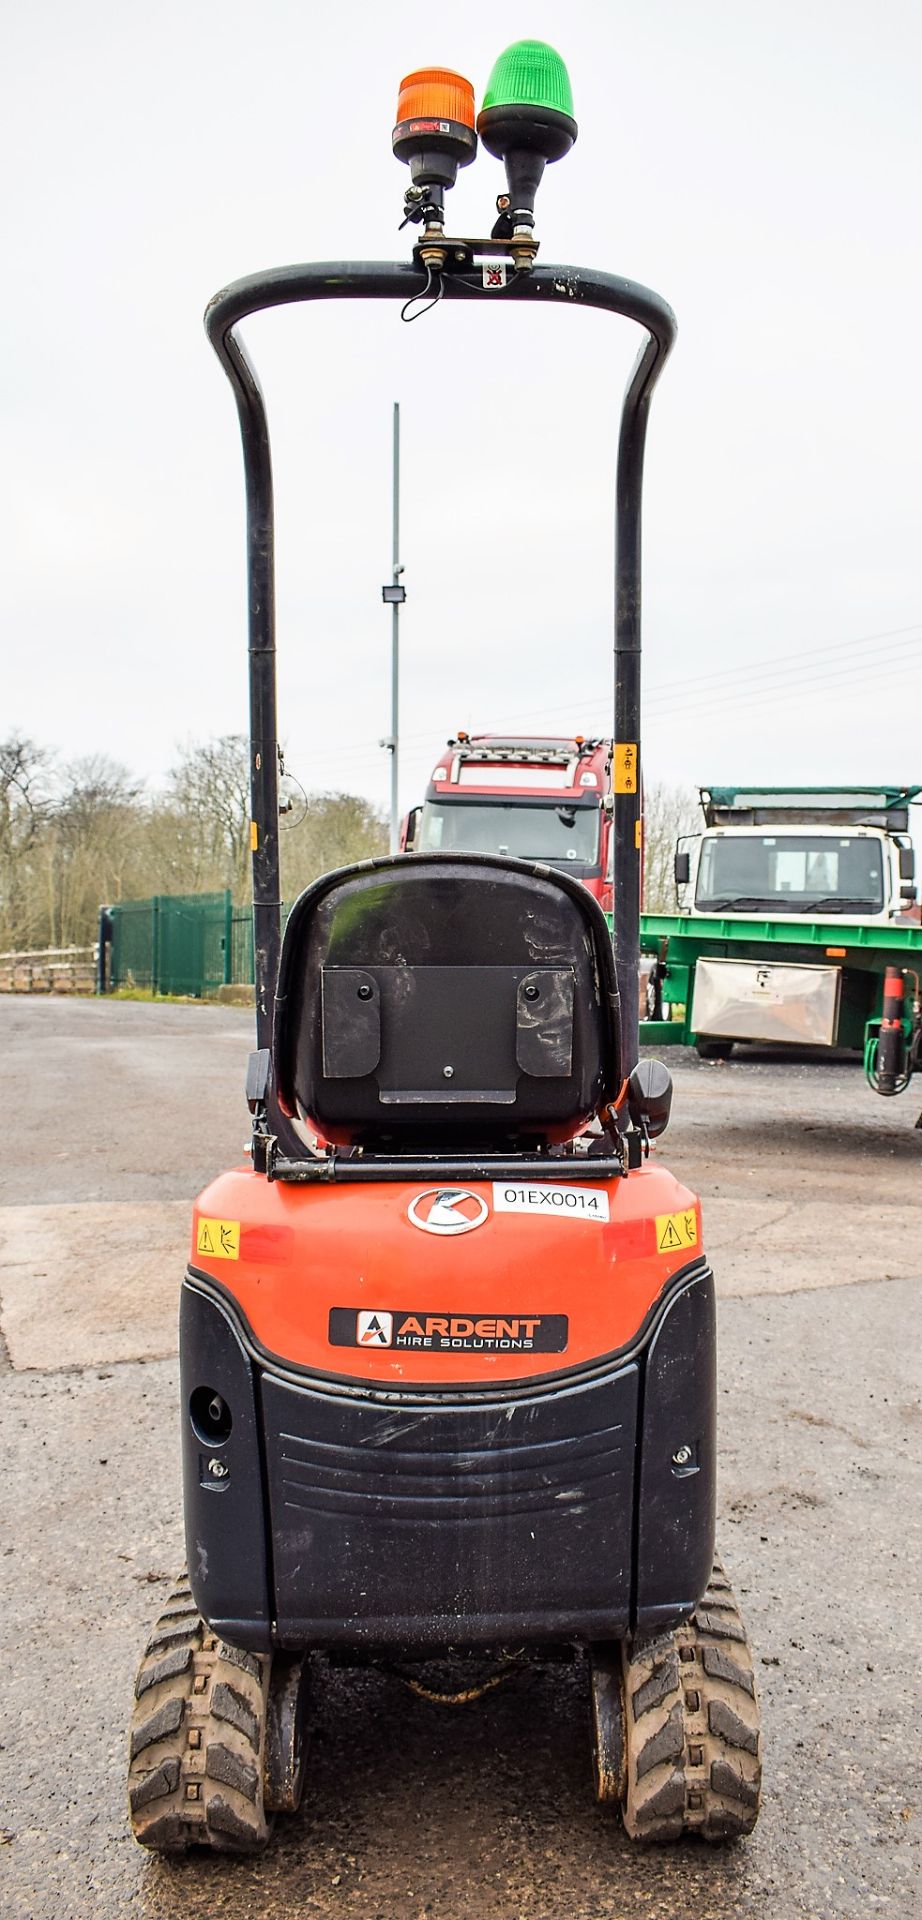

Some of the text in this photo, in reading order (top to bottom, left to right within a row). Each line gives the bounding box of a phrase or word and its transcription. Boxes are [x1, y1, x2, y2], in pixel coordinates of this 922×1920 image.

[504, 1189, 598, 1210] 01EX0014
[397, 1316, 541, 1338] ARDENT
[396, 1336, 534, 1348] HIRE SOLUTIONS
